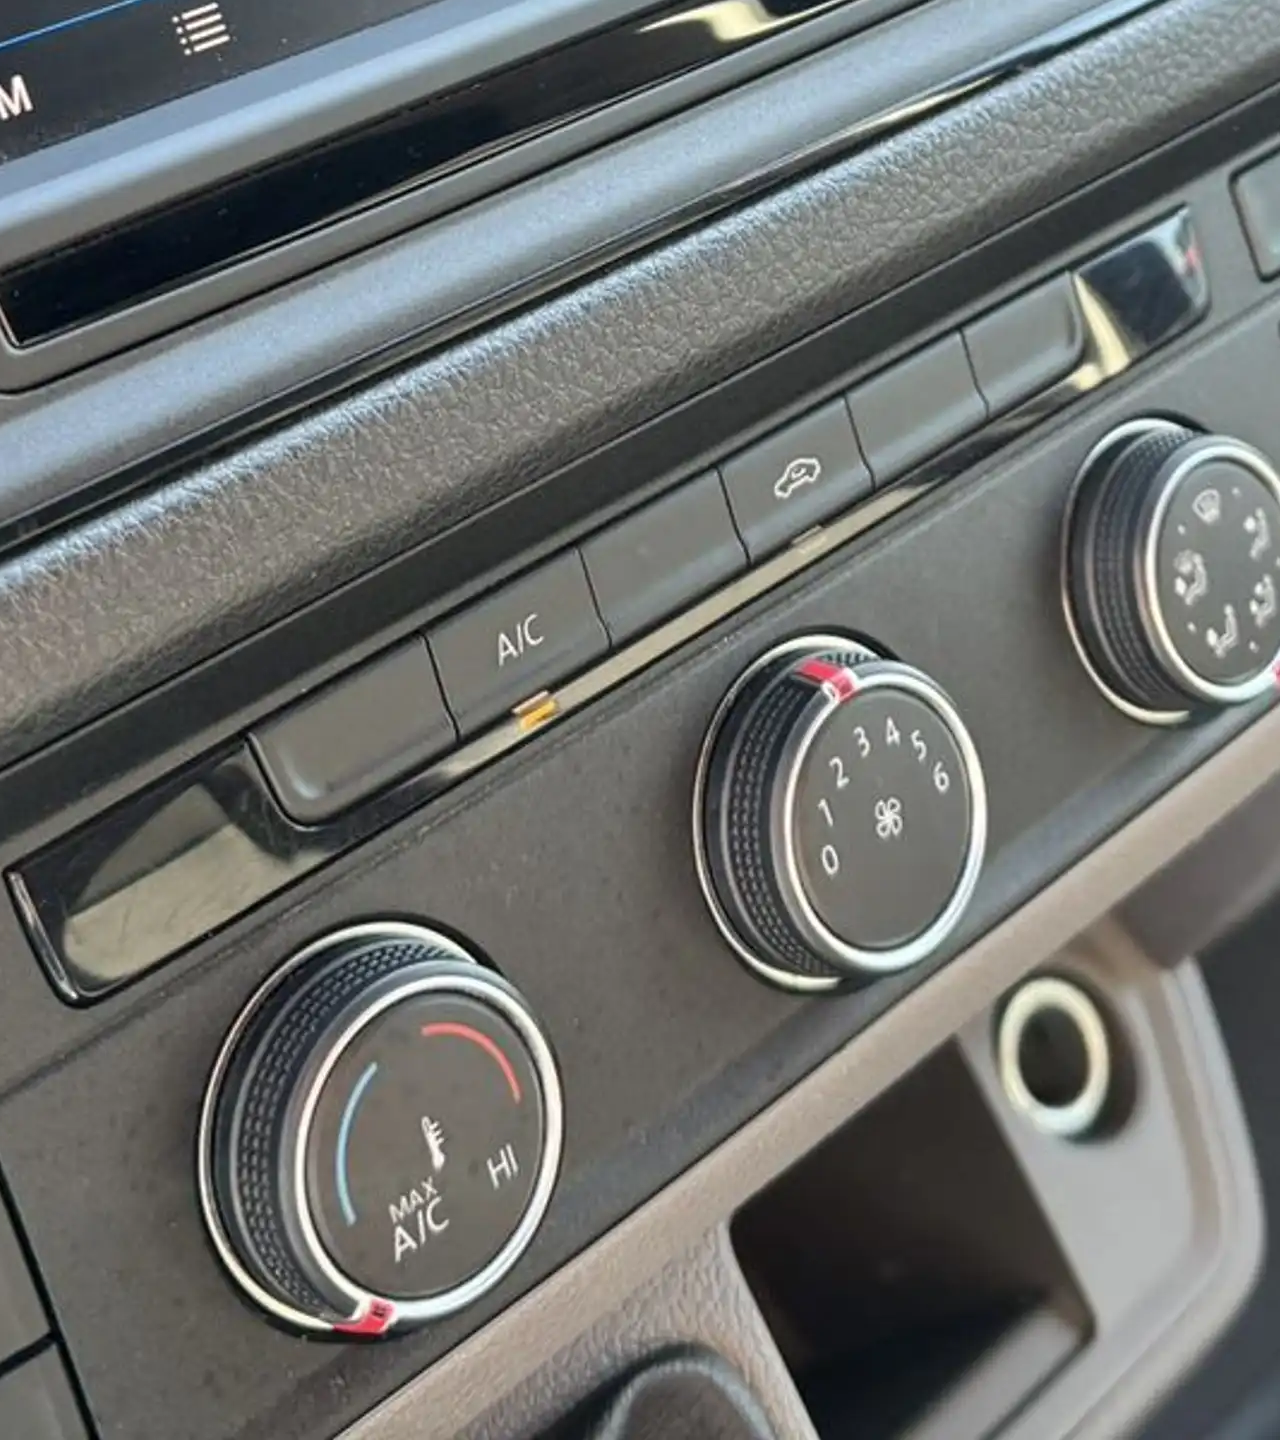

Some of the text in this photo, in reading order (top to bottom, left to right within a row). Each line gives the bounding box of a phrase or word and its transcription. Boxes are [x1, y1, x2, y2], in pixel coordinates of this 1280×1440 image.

[496, 613, 544, 666] A/C
[817, 717, 951, 877] 0 1 2 3 4 5 6
[487, 1143, 519, 1190] HI
[387, 1176, 440, 1224] MAX
[393, 1197, 450, 1263] A/C
